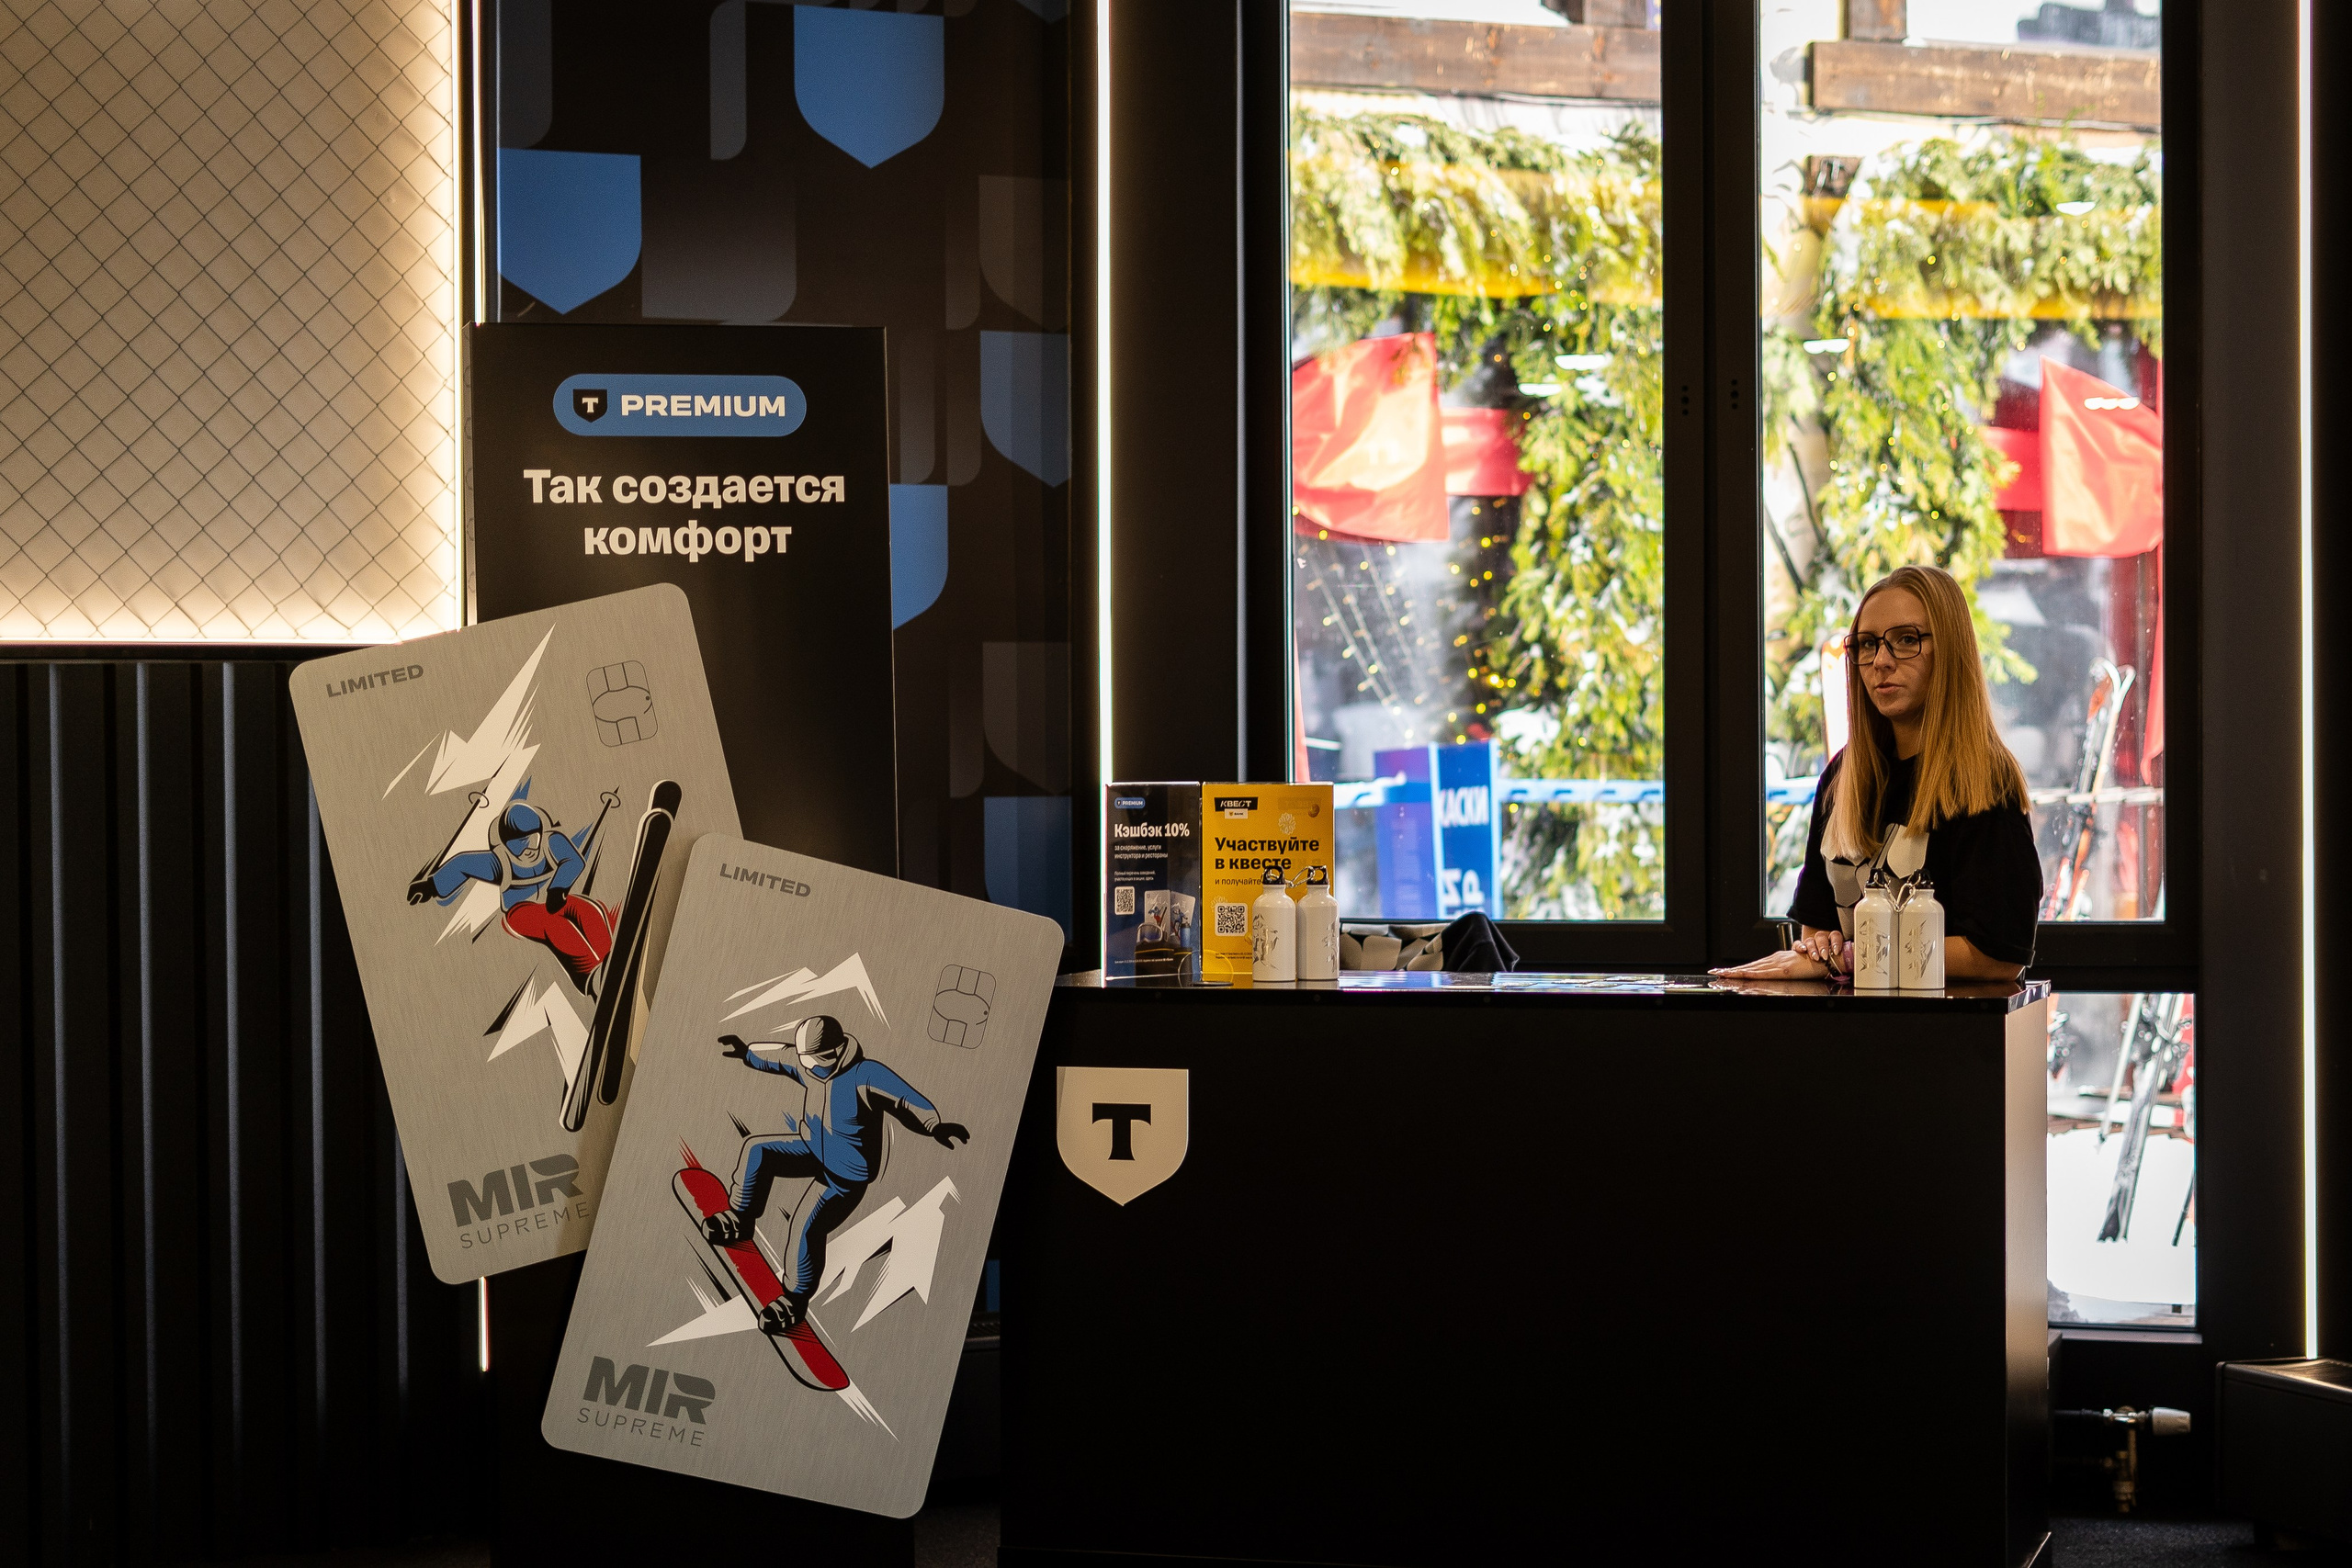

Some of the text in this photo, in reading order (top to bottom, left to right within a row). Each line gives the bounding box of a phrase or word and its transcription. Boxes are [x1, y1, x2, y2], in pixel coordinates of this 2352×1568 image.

[582, 394, 786, 418] T PREMIUM
[523, 468, 845, 510] Так создается
[583, 519, 793, 563] комфорт
[325, 663, 424, 698] LIMITED
[1114, 822, 1191, 838] Кэшбэк 10%
[1214, 836, 1320, 855] Участвуйте
[719, 863, 811, 897] LIMITED
[1215, 857, 1292, 870] в квесте
[1221, 877, 1261, 887] получайте
[1091, 1102, 1152, 1161] T
[447, 1153, 584, 1228] MIR
[459, 1201, 591, 1249] SUPREME
[582, 1355, 716, 1425] MIR
[577, 1407, 705, 1448] SUPREME
